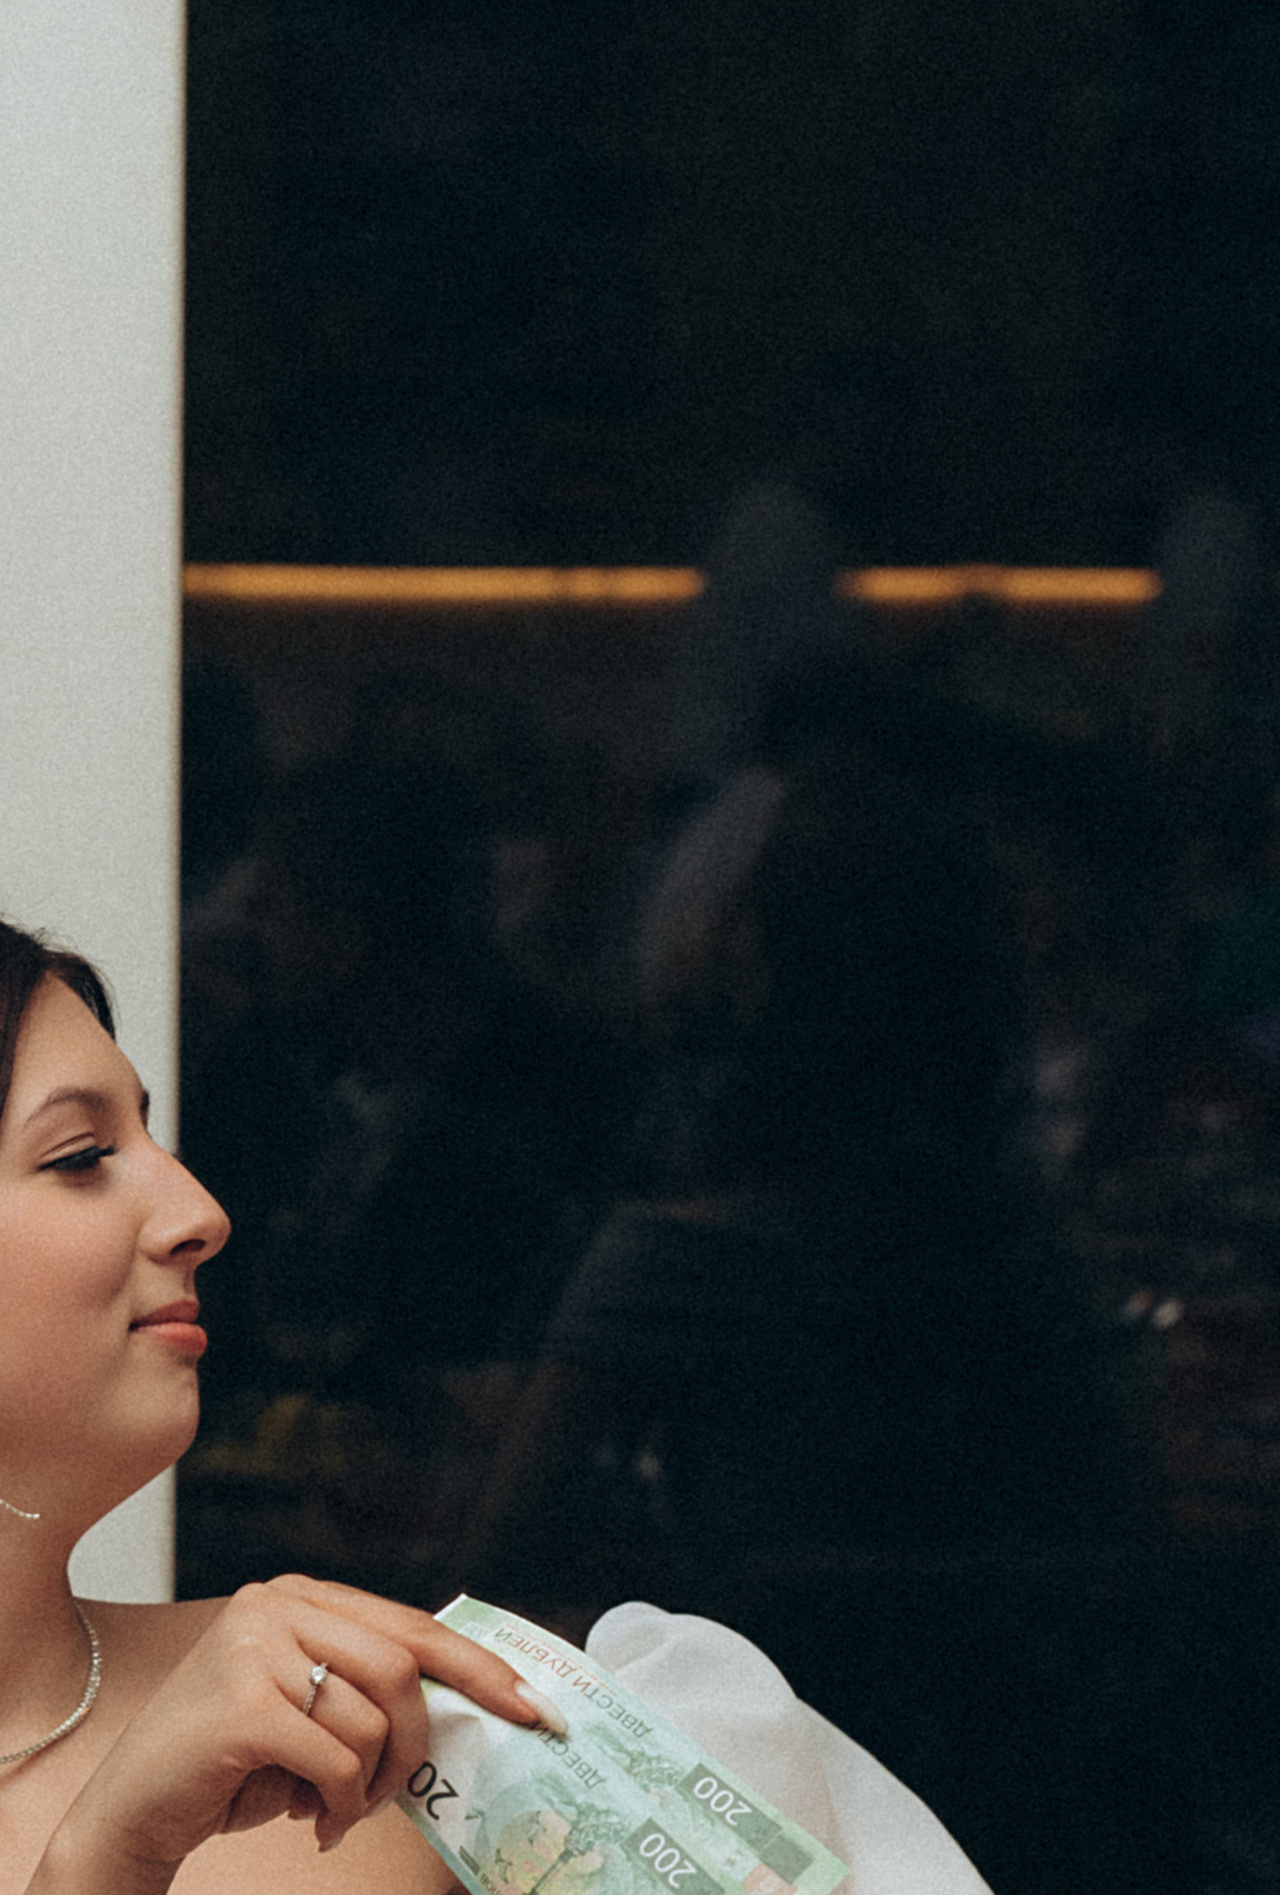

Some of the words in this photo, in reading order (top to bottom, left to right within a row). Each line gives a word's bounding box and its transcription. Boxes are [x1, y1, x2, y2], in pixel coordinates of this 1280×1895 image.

[493, 1626, 580, 1679] ДУБЛЕЙ
[572, 1674, 654, 1739] ДВЕСТИ
[529, 1719, 607, 1790] ДВЕСТИ
[407, 1760, 460, 1821] 20
[693, 1776, 753, 1826] 200
[638, 1832, 698, 1889] 200
